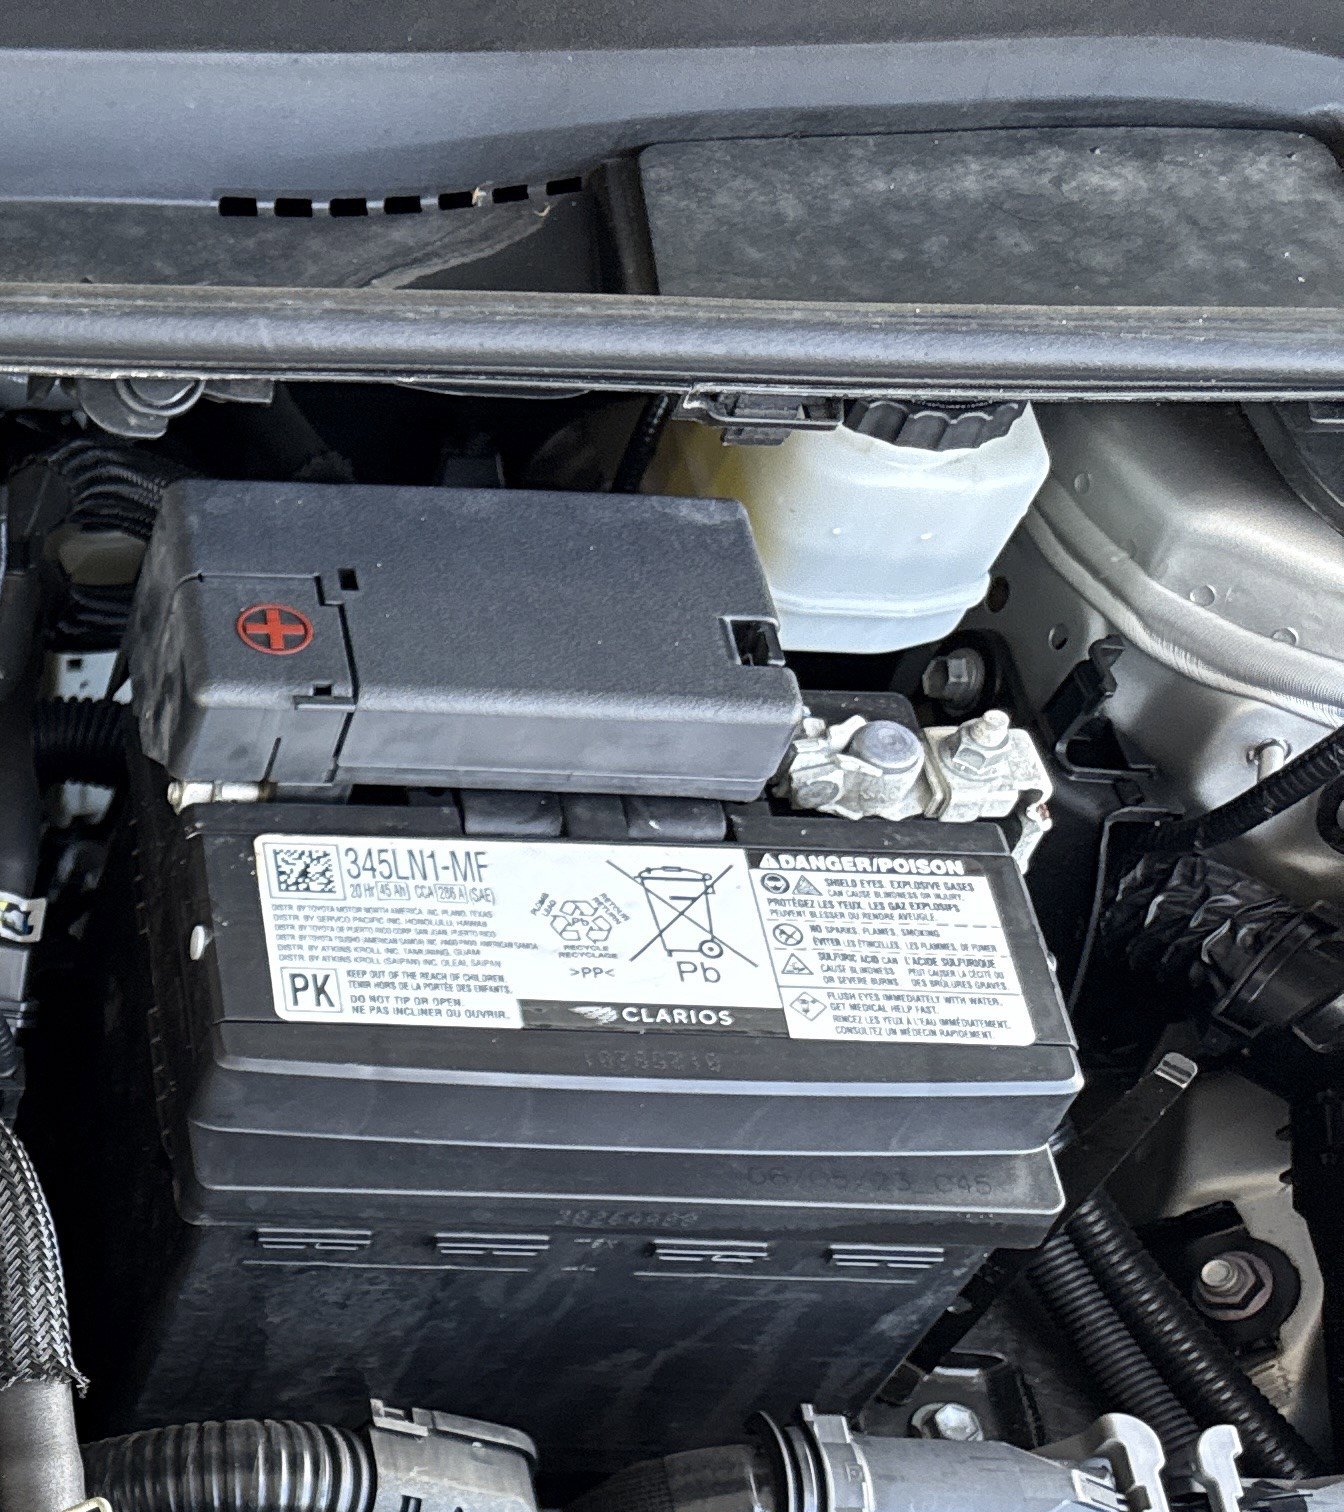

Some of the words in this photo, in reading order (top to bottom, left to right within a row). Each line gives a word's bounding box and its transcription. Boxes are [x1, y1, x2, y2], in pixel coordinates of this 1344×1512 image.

[344, 848, 489, 882] 345LN1-MF
[778, 854, 964, 875] DANGER/POISON
[823, 877, 858, 888] SHIELD
[888, 879, 941, 890] EXPLOSIVE
[942, 881, 975, 891] GASES
[414, 885, 434, 898] CCA
[469, 887, 496, 906] (SAE)
[344, 968, 368, 978] KEEP
[368, 969, 386, 979] OUT
[387, 970, 400, 979] OF
[401, 970, 417, 979] THE
[418, 971, 448, 981] REACH
[448, 972, 461, 981] OF
[569, 967, 615, 978] >PP<
[676, 961, 721, 983] Pb
[288, 973, 336, 1008] PK
[348, 994, 366, 1003] DO
[367, 994, 390, 1003] NOT
[393, 995, 411, 1004] TIP
[412, 996, 429, 1005] OR
[350, 1004, 366, 1014] NE
[367, 1005, 390, 1015] PAS
[391, 1006, 443, 1017] INCLINER
[444, 1008, 462, 1018] OU
[622, 1007, 735, 1026] CLARIOS
